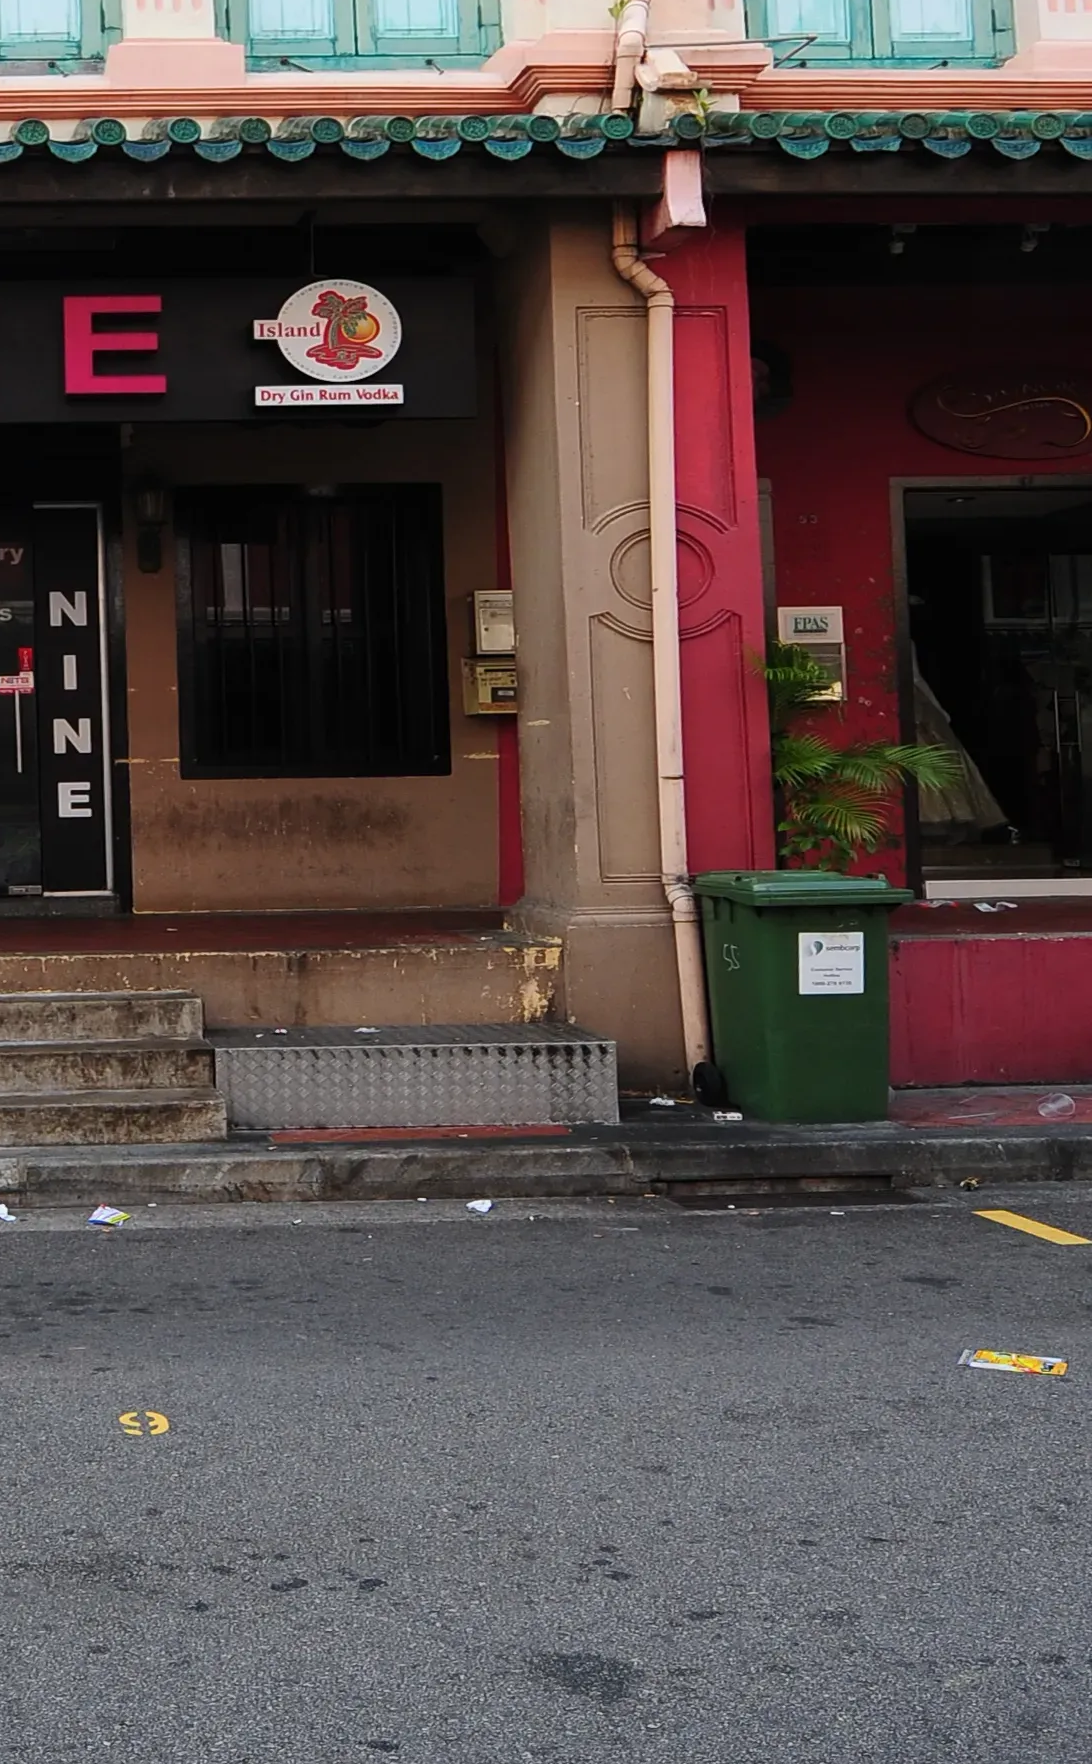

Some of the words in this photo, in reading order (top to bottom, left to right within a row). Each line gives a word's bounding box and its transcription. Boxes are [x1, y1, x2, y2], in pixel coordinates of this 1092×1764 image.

[258, 322, 322, 338] Island
[260, 390, 286, 404] Dry
[290, 389, 314, 402] Gin
[318, 389, 351, 401] Rum
[356, 388, 399, 401] Vodka
